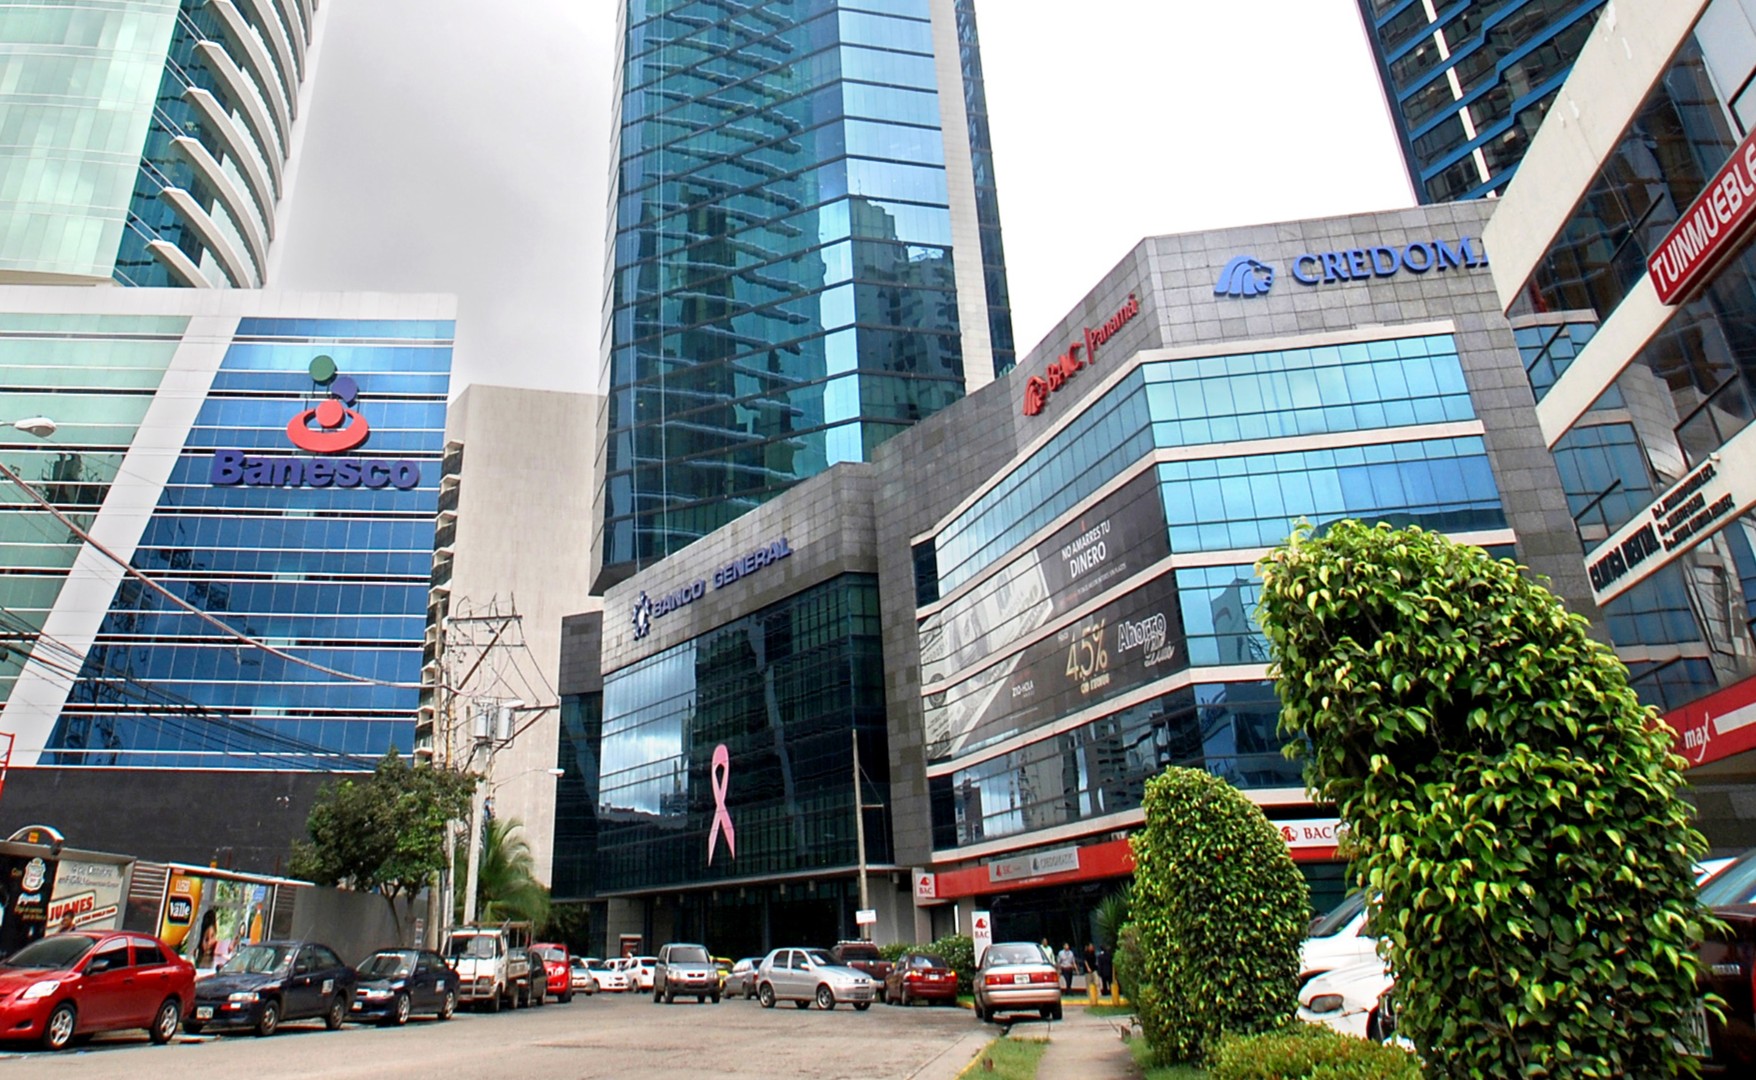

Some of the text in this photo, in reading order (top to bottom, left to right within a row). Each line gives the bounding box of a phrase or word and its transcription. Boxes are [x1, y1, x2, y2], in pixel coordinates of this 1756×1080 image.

[1292, 236, 1490, 285] CREDOM
[212, 449, 420, 490] Banesco
[1061, 519, 1111, 561] NO AMARRES TU
[652, 537, 793, 618] BANCO GENERAL
[1070, 541, 1107, 579] DINERO
[1118, 612, 1167, 653] Ahorro
[1303, 826, 1332, 840] BAC
[50, 896, 94, 921] JUANES
[918, 887, 933, 895] BAC
[974, 931, 989, 939] BAC
